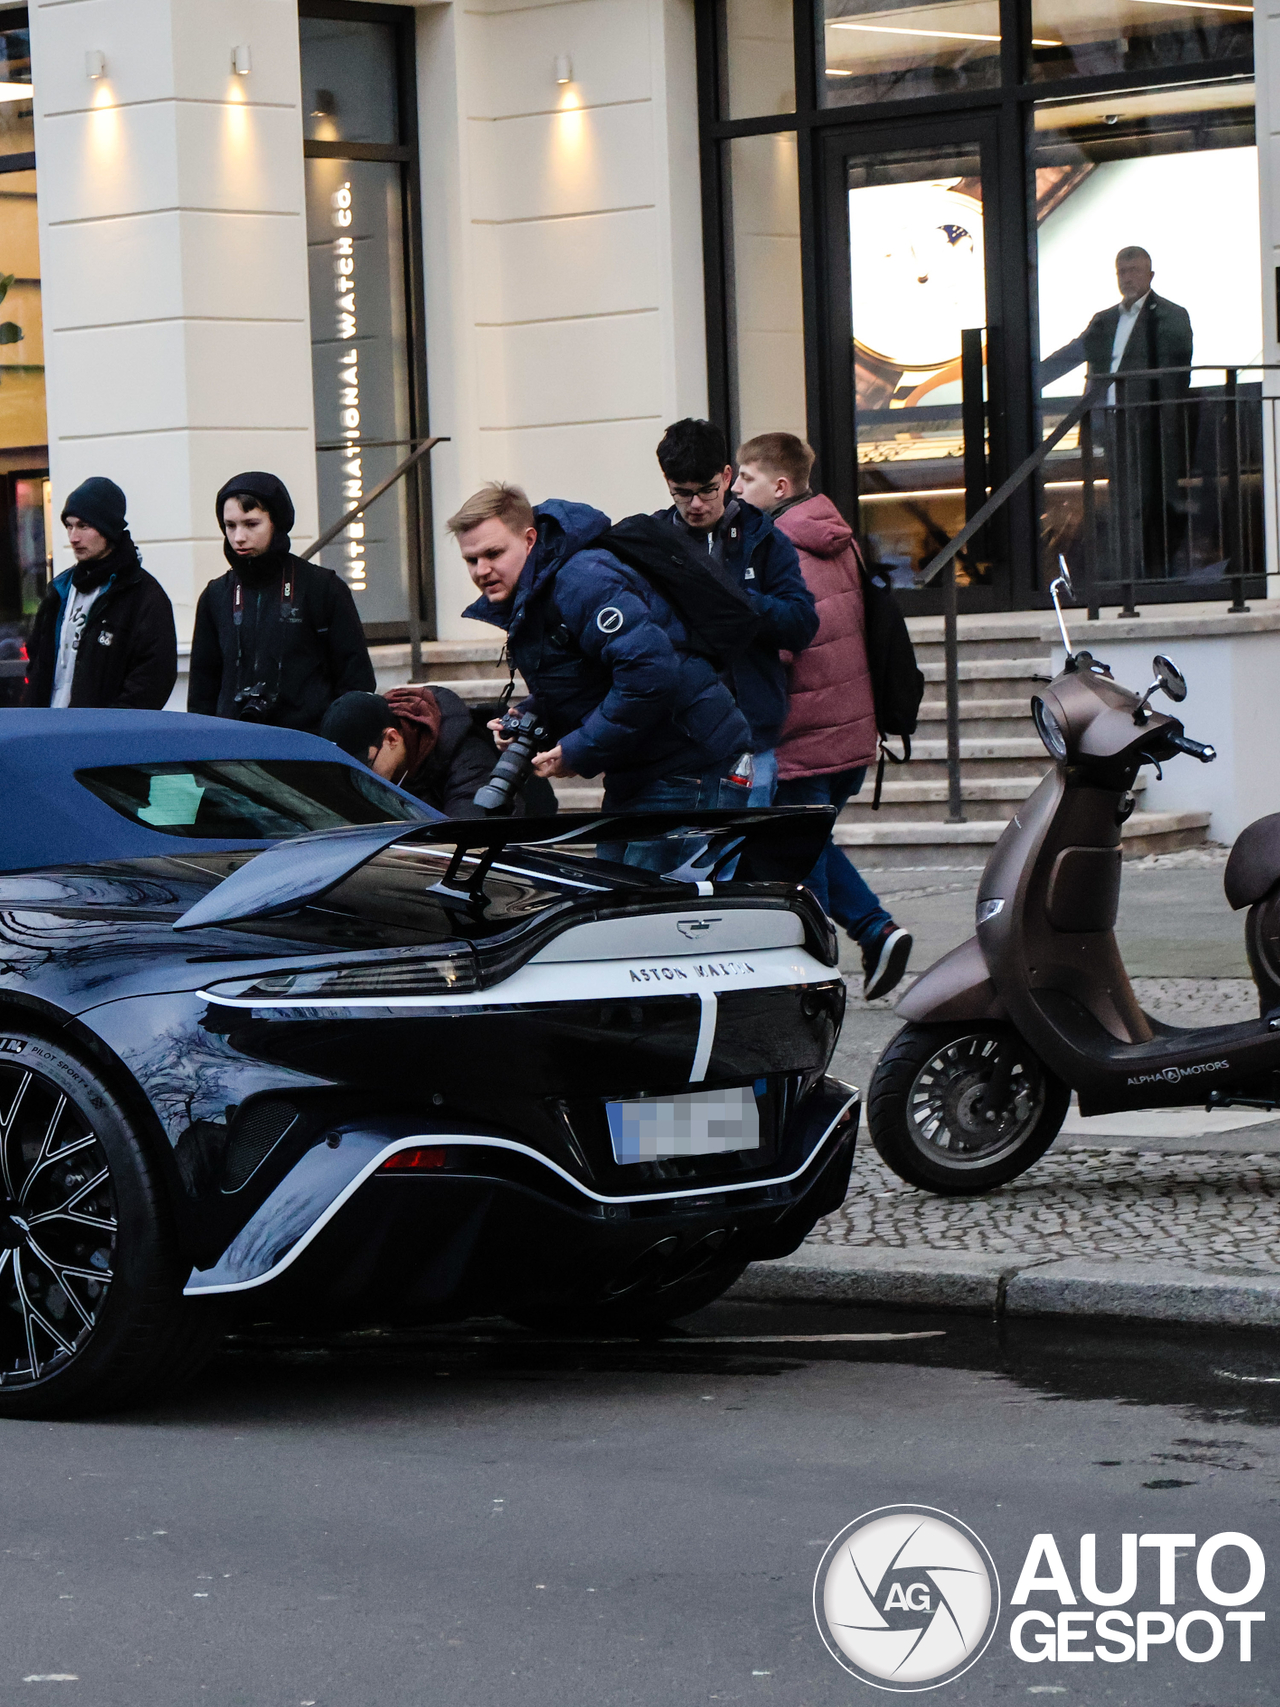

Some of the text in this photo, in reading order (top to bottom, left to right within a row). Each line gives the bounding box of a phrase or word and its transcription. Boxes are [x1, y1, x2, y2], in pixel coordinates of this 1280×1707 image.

[333, 181, 354, 228] CO.
[336, 236, 358, 340] WATCH
[629, 966, 687, 983] ASTON
[31, 1046, 57, 1062] PILOT
[57, 1060, 85, 1085] SPORT
[1127, 1059, 1230, 1086] ALPHA MOTORS
